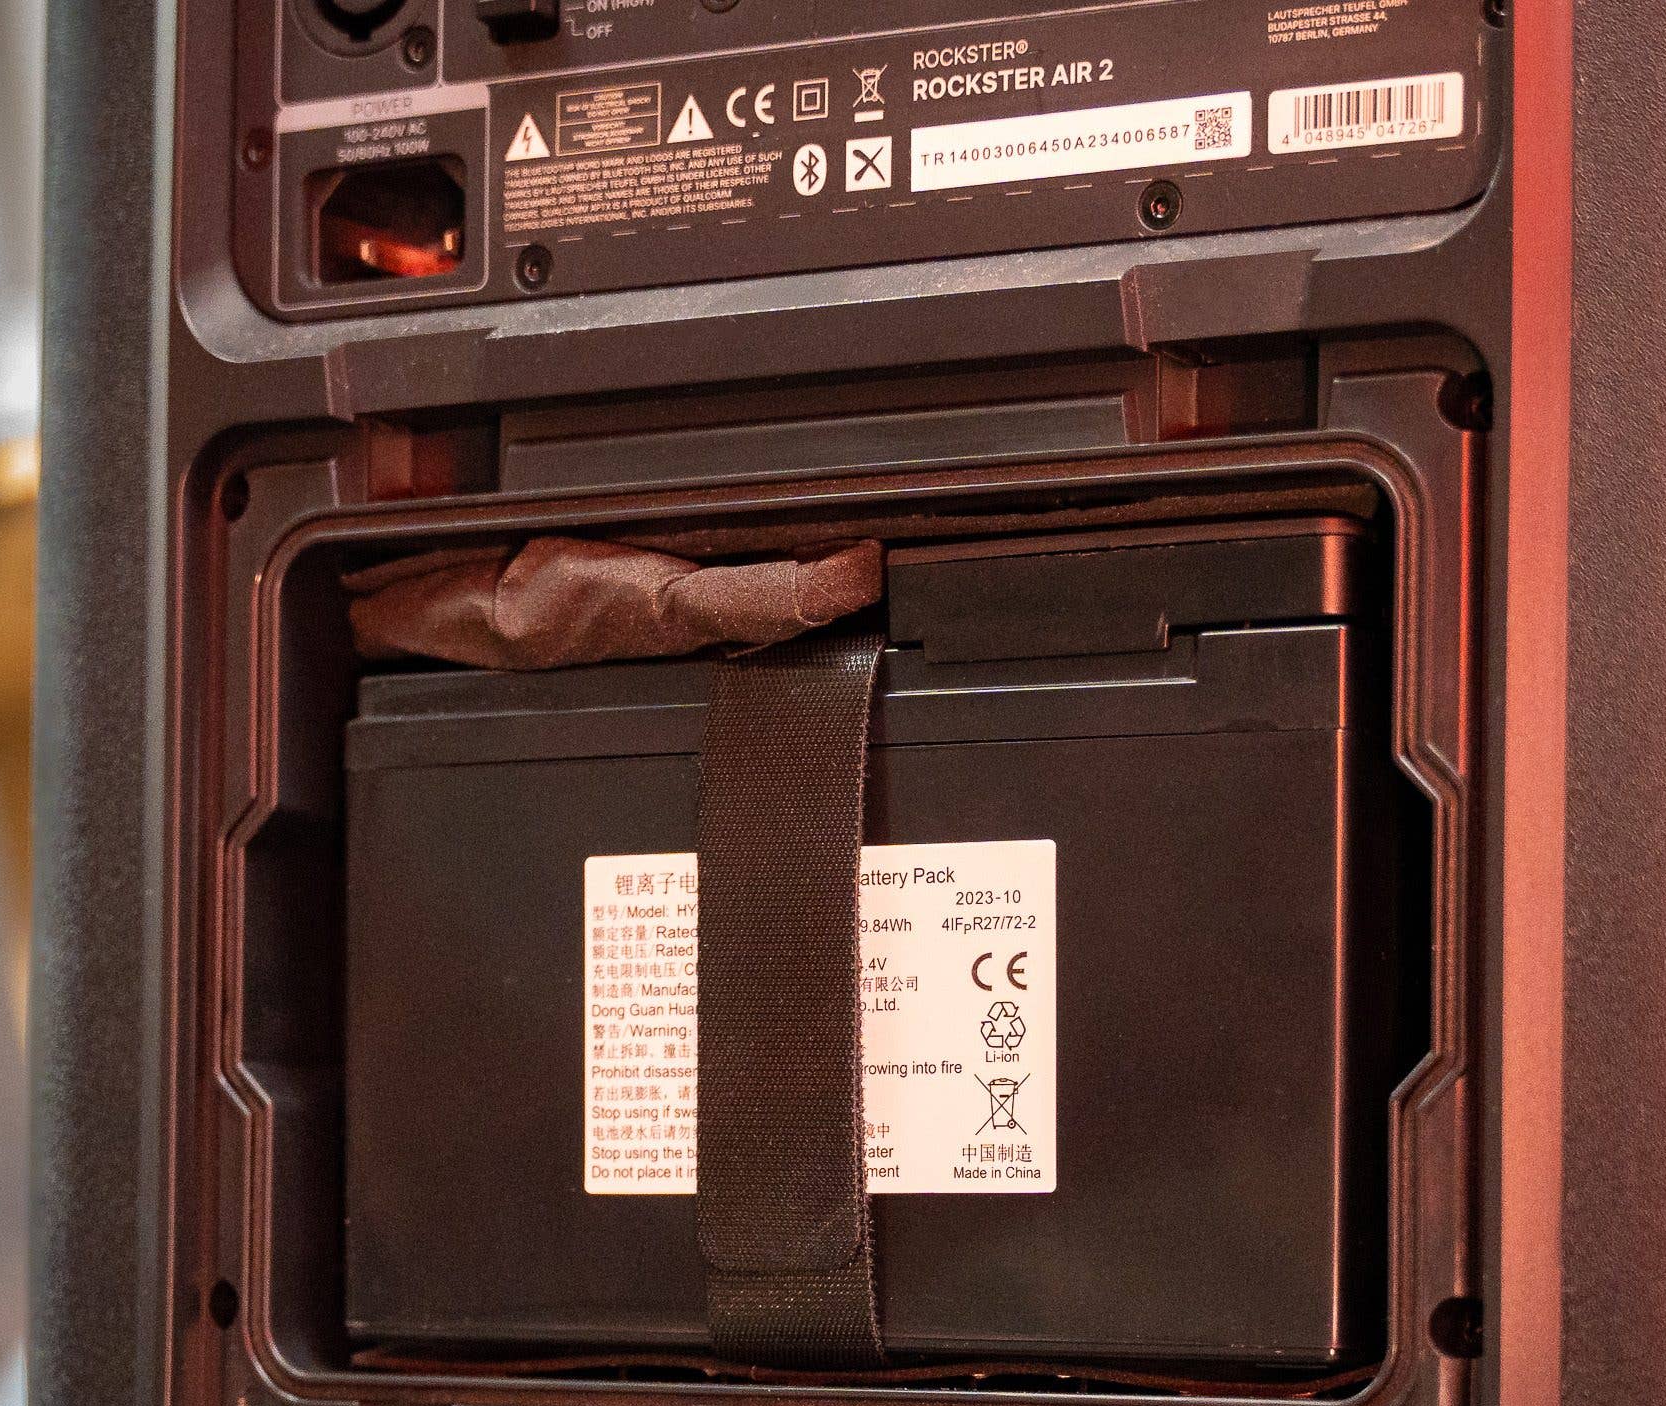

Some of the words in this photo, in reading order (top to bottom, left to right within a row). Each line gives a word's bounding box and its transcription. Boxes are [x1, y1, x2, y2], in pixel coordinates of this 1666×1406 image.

[1268, 5, 1340, 21] LAUTSPRECHER
[1343, 1, 1376, 12] TEUFEL
[587, 24, 613, 39] OFF
[1268, 18, 1327, 33] BUDAPESTER
[1329, 13, 1371, 26] STRASSE
[1268, 33, 1293, 44] 10787
[1295, 29, 1331, 41] BERLIN,
[1332, 23, 1379, 37] GERMANY
[913, 39, 1028, 70] ROCKSTER®
[912, 65, 1045, 101] ROCKSTER
[1051, 61, 1093, 87] AIR
[1099, 59, 1114, 81] 2
[353, 96, 413, 118] POWER
[1305, 127, 1365, 145] 048945
[1377, 119, 1437, 137] 047267
[645, 152, 673, 162] LOGOS
[675, 150, 691, 159] ARE
[693, 144, 743, 157] REGISTERED
[921, 124, 1190, 167] TR14003006450A234006587
[687, 160, 707, 169] AND
[707, 158, 725, 167] ANY
[727, 156, 743, 165] USE
[745, 154, 757, 163] OF
[757, 152, 783, 162] SUCH
[675, 171, 705, 181] UNDER
[743, 164, 772, 174] OTHER
[653, 184, 679, 195] THOSE
[681, 183, 693, 192] OF
[695, 180, 719, 190] THEIR
[719, 175, 770, 188] RESPECTIVE
[669, 195, 682, 204] OF
[683, 190, 733, 203] QUALCOMM
[683, 205, 696, 214] ITS
[615, 872, 698, 896] 锂离子电
[860, 870, 908, 889] attery
[913, 866, 956, 884] Pack
[955, 889, 1022, 905] 2023-10
[677, 903, 697, 918] HY
[860, 918, 912, 933] 9.84Wh
[594, 962, 698, 979] 充电限制电压/C
[861, 957, 887, 971] .4V
[593, 982, 698, 998] 制造商/Manufac
[592, 1004, 625, 1020] Dong
[629, 1003, 665, 1016] Guan
[668, 1003, 698, 1016] Hua
[859, 997, 900, 1013] o.,Ltd.
[985, 1051, 1020, 1063] Li-ion
[592, 1065, 640, 1078] Prohibit
[863, 1062, 908, 1078] rowing
[912, 1061, 937, 1075] into
[941, 1060, 963, 1074] fire
[593, 1084, 697, 1101] 若出现膨胀，请
[592, 1105, 621, 1120] Stop
[624, 1106, 659, 1121] using
[662, 1104, 670, 1118] if
[674, 1108, 697, 1118] swe
[592, 1146, 621, 1160] Stop
[624, 1147, 659, 1162] using
[663, 1146, 683, 1159] the
[864, 1147, 894, 1159] ater
[962, 1143, 1033, 1163] 中国制造
[592, 1165, 610, 1178] Do
[614, 1165, 634, 1178] not
[637, 1165, 671, 1181] place
[675, 1165, 683, 1178] it
[866, 1165, 900, 1178] ment
[953, 1166, 987, 1179] Made
[991, 1166, 1002, 1179] in
[1005, 1166, 1041, 1179] China
